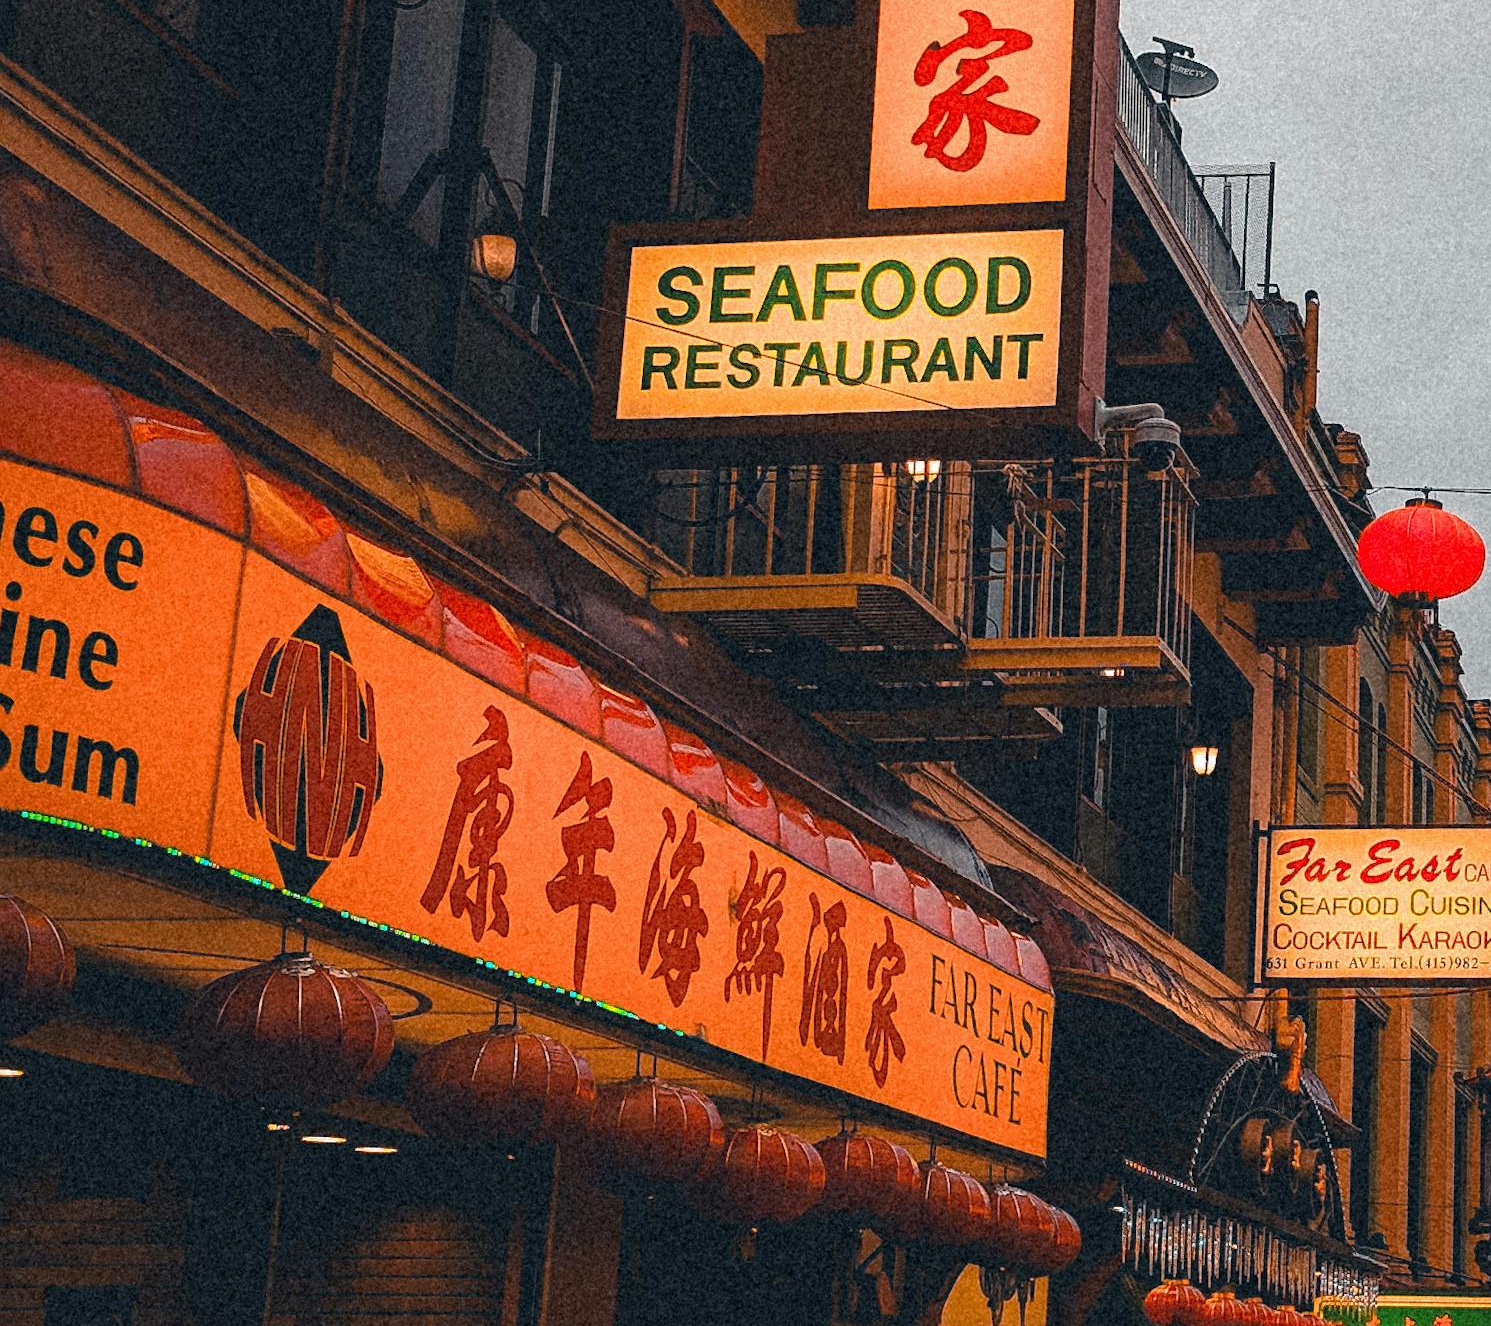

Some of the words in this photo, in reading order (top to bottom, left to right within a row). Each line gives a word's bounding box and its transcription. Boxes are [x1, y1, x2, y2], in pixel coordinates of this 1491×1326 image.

[1170, 63, 1207, 78] DIRECTV
[655, 256, 1032, 327] SEAFOOD
[640, 333, 1044, 391] RESTAURANT
[0, 500, 144, 591] ese
[1277, 838, 1352, 885] Far
[1360, 839, 1463, 883] East
[420, 705, 906, 1088] 康年海鮮酒家
[1279, 888, 1398, 915] SEAFOOD
[1266, 957, 1287, 969] 631
[1295, 957, 1340, 969] Grant
[1273, 923, 1387, 949] COCKTAIL
[929, 954, 979, 1038] FAR
[988, 983, 1048, 1063] EAST
[953, 1045, 1022, 1125] CAFÉ
